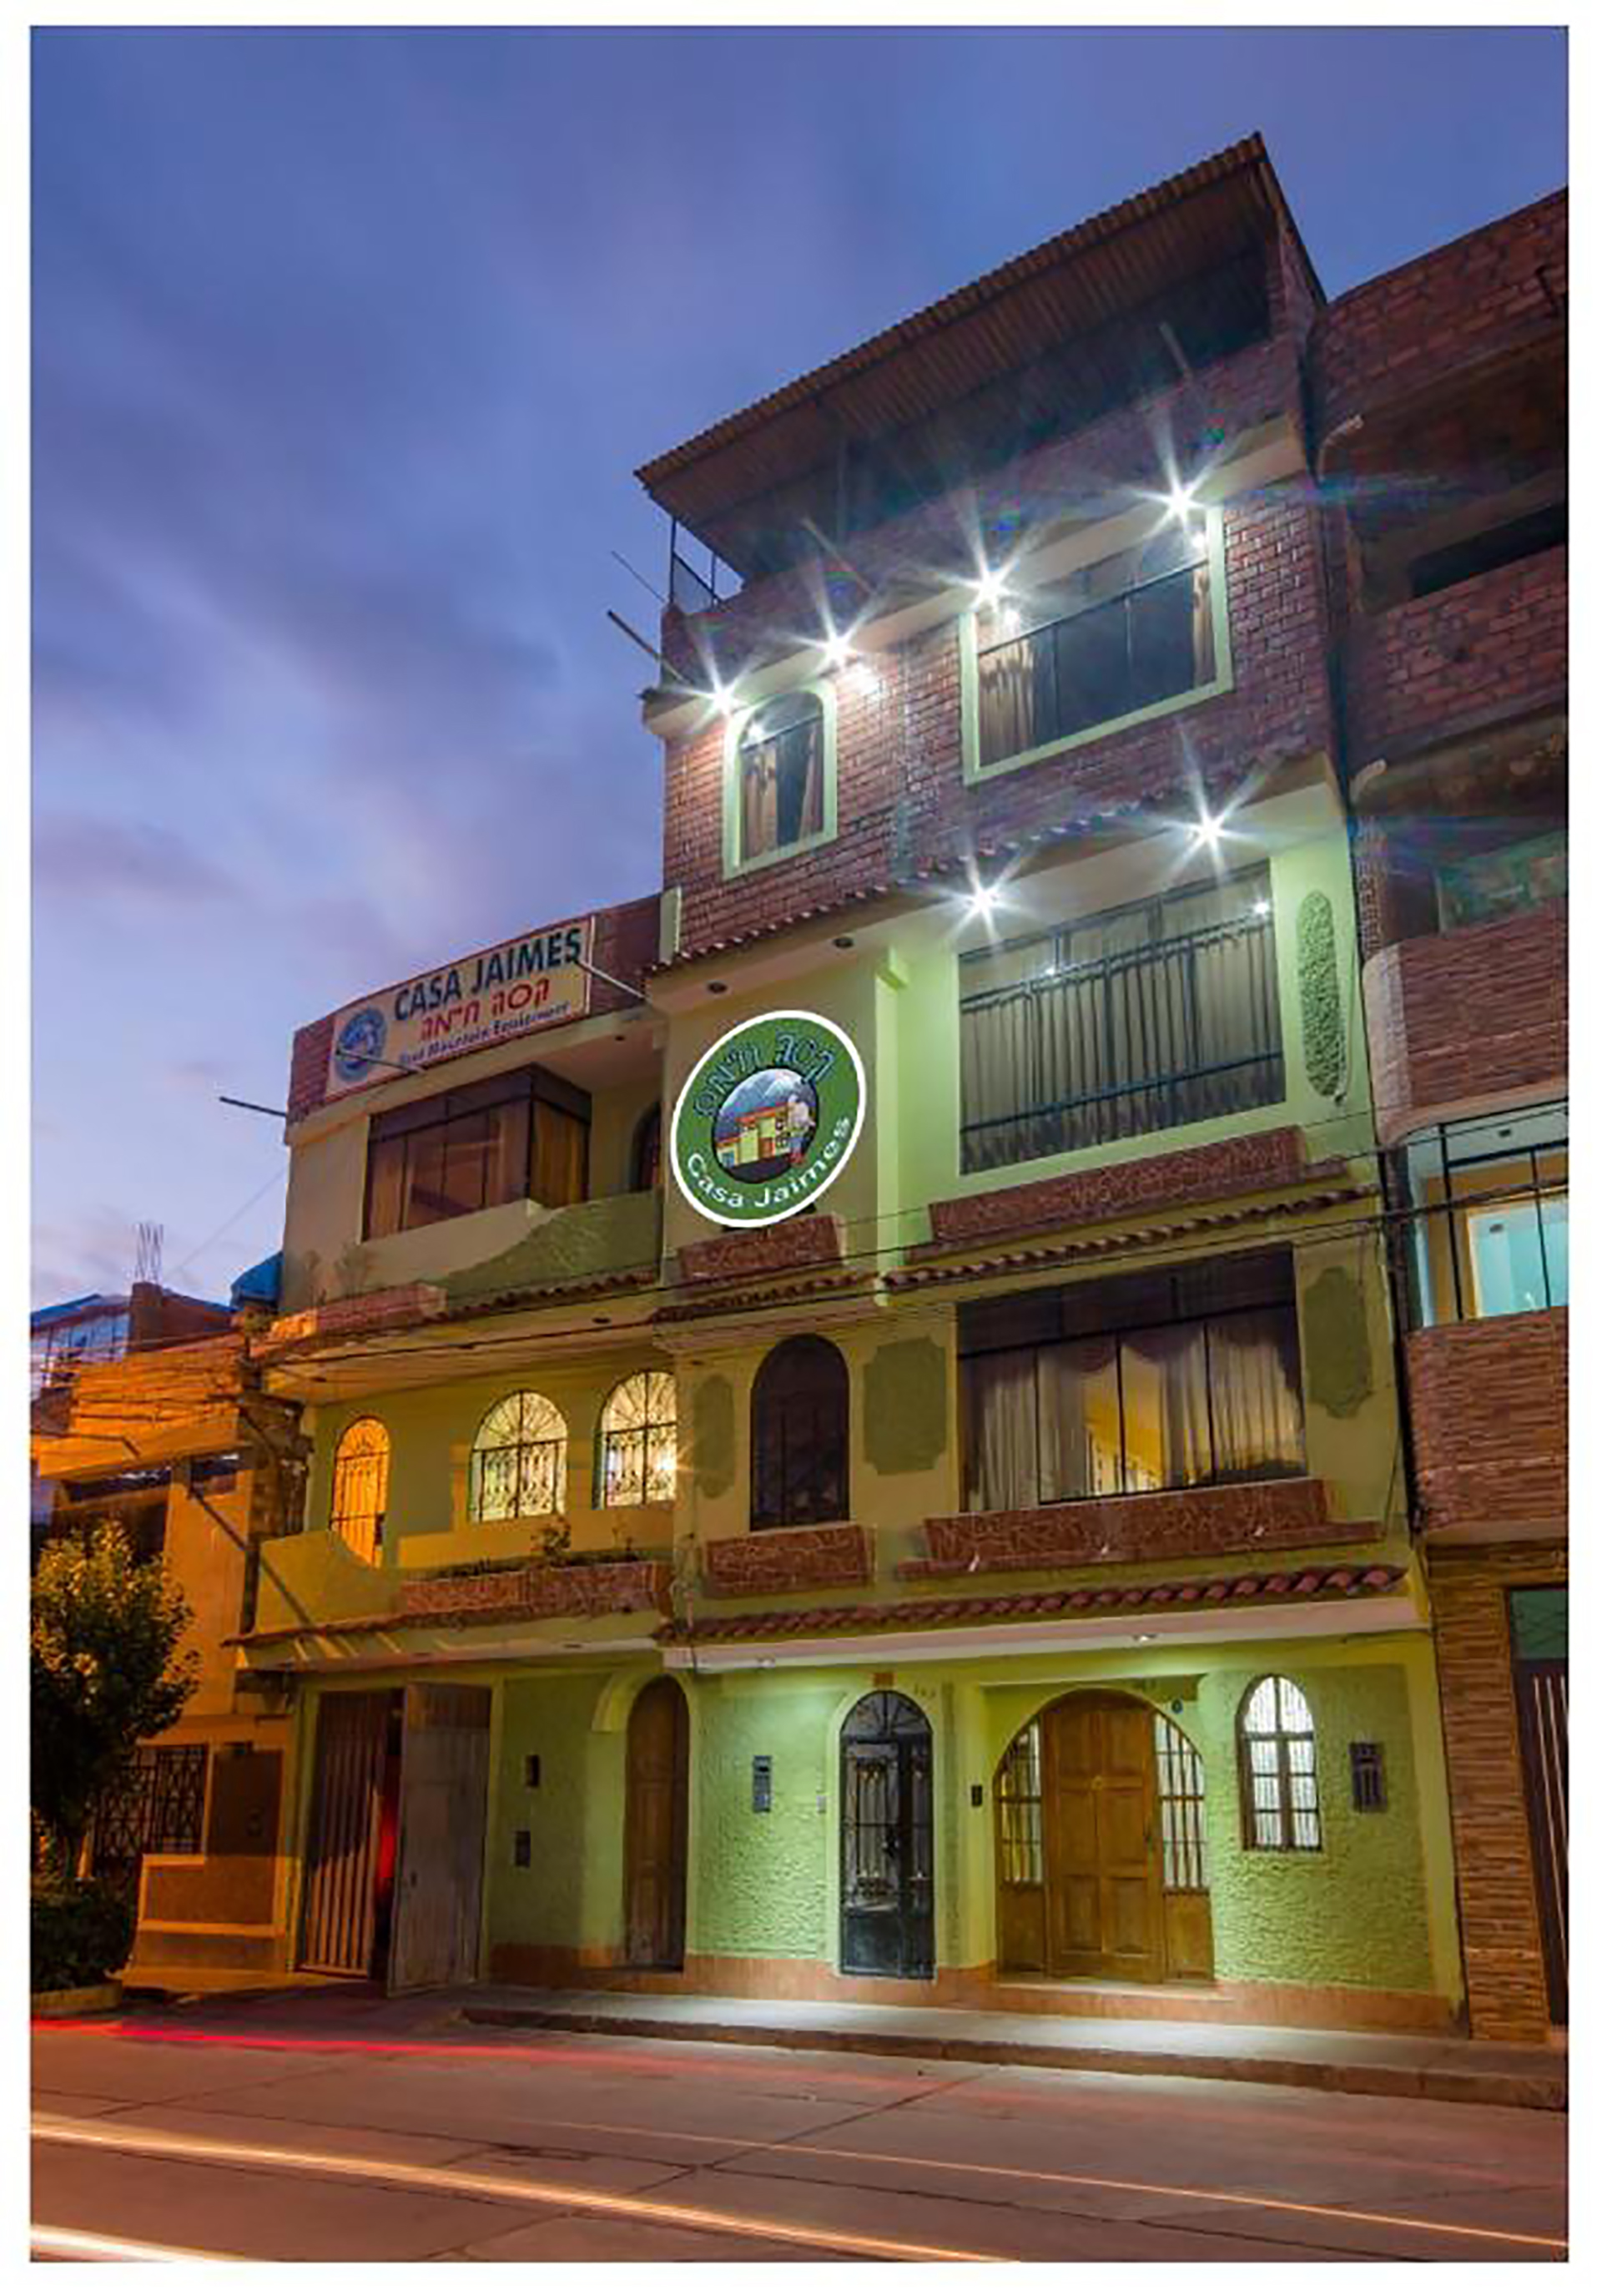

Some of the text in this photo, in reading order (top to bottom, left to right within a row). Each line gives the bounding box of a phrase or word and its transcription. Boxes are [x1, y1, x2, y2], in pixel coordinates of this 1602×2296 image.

[395, 928, 581, 1020] CASA JAIMES
[688, 1118, 850, 1208] Casa Jaimes
